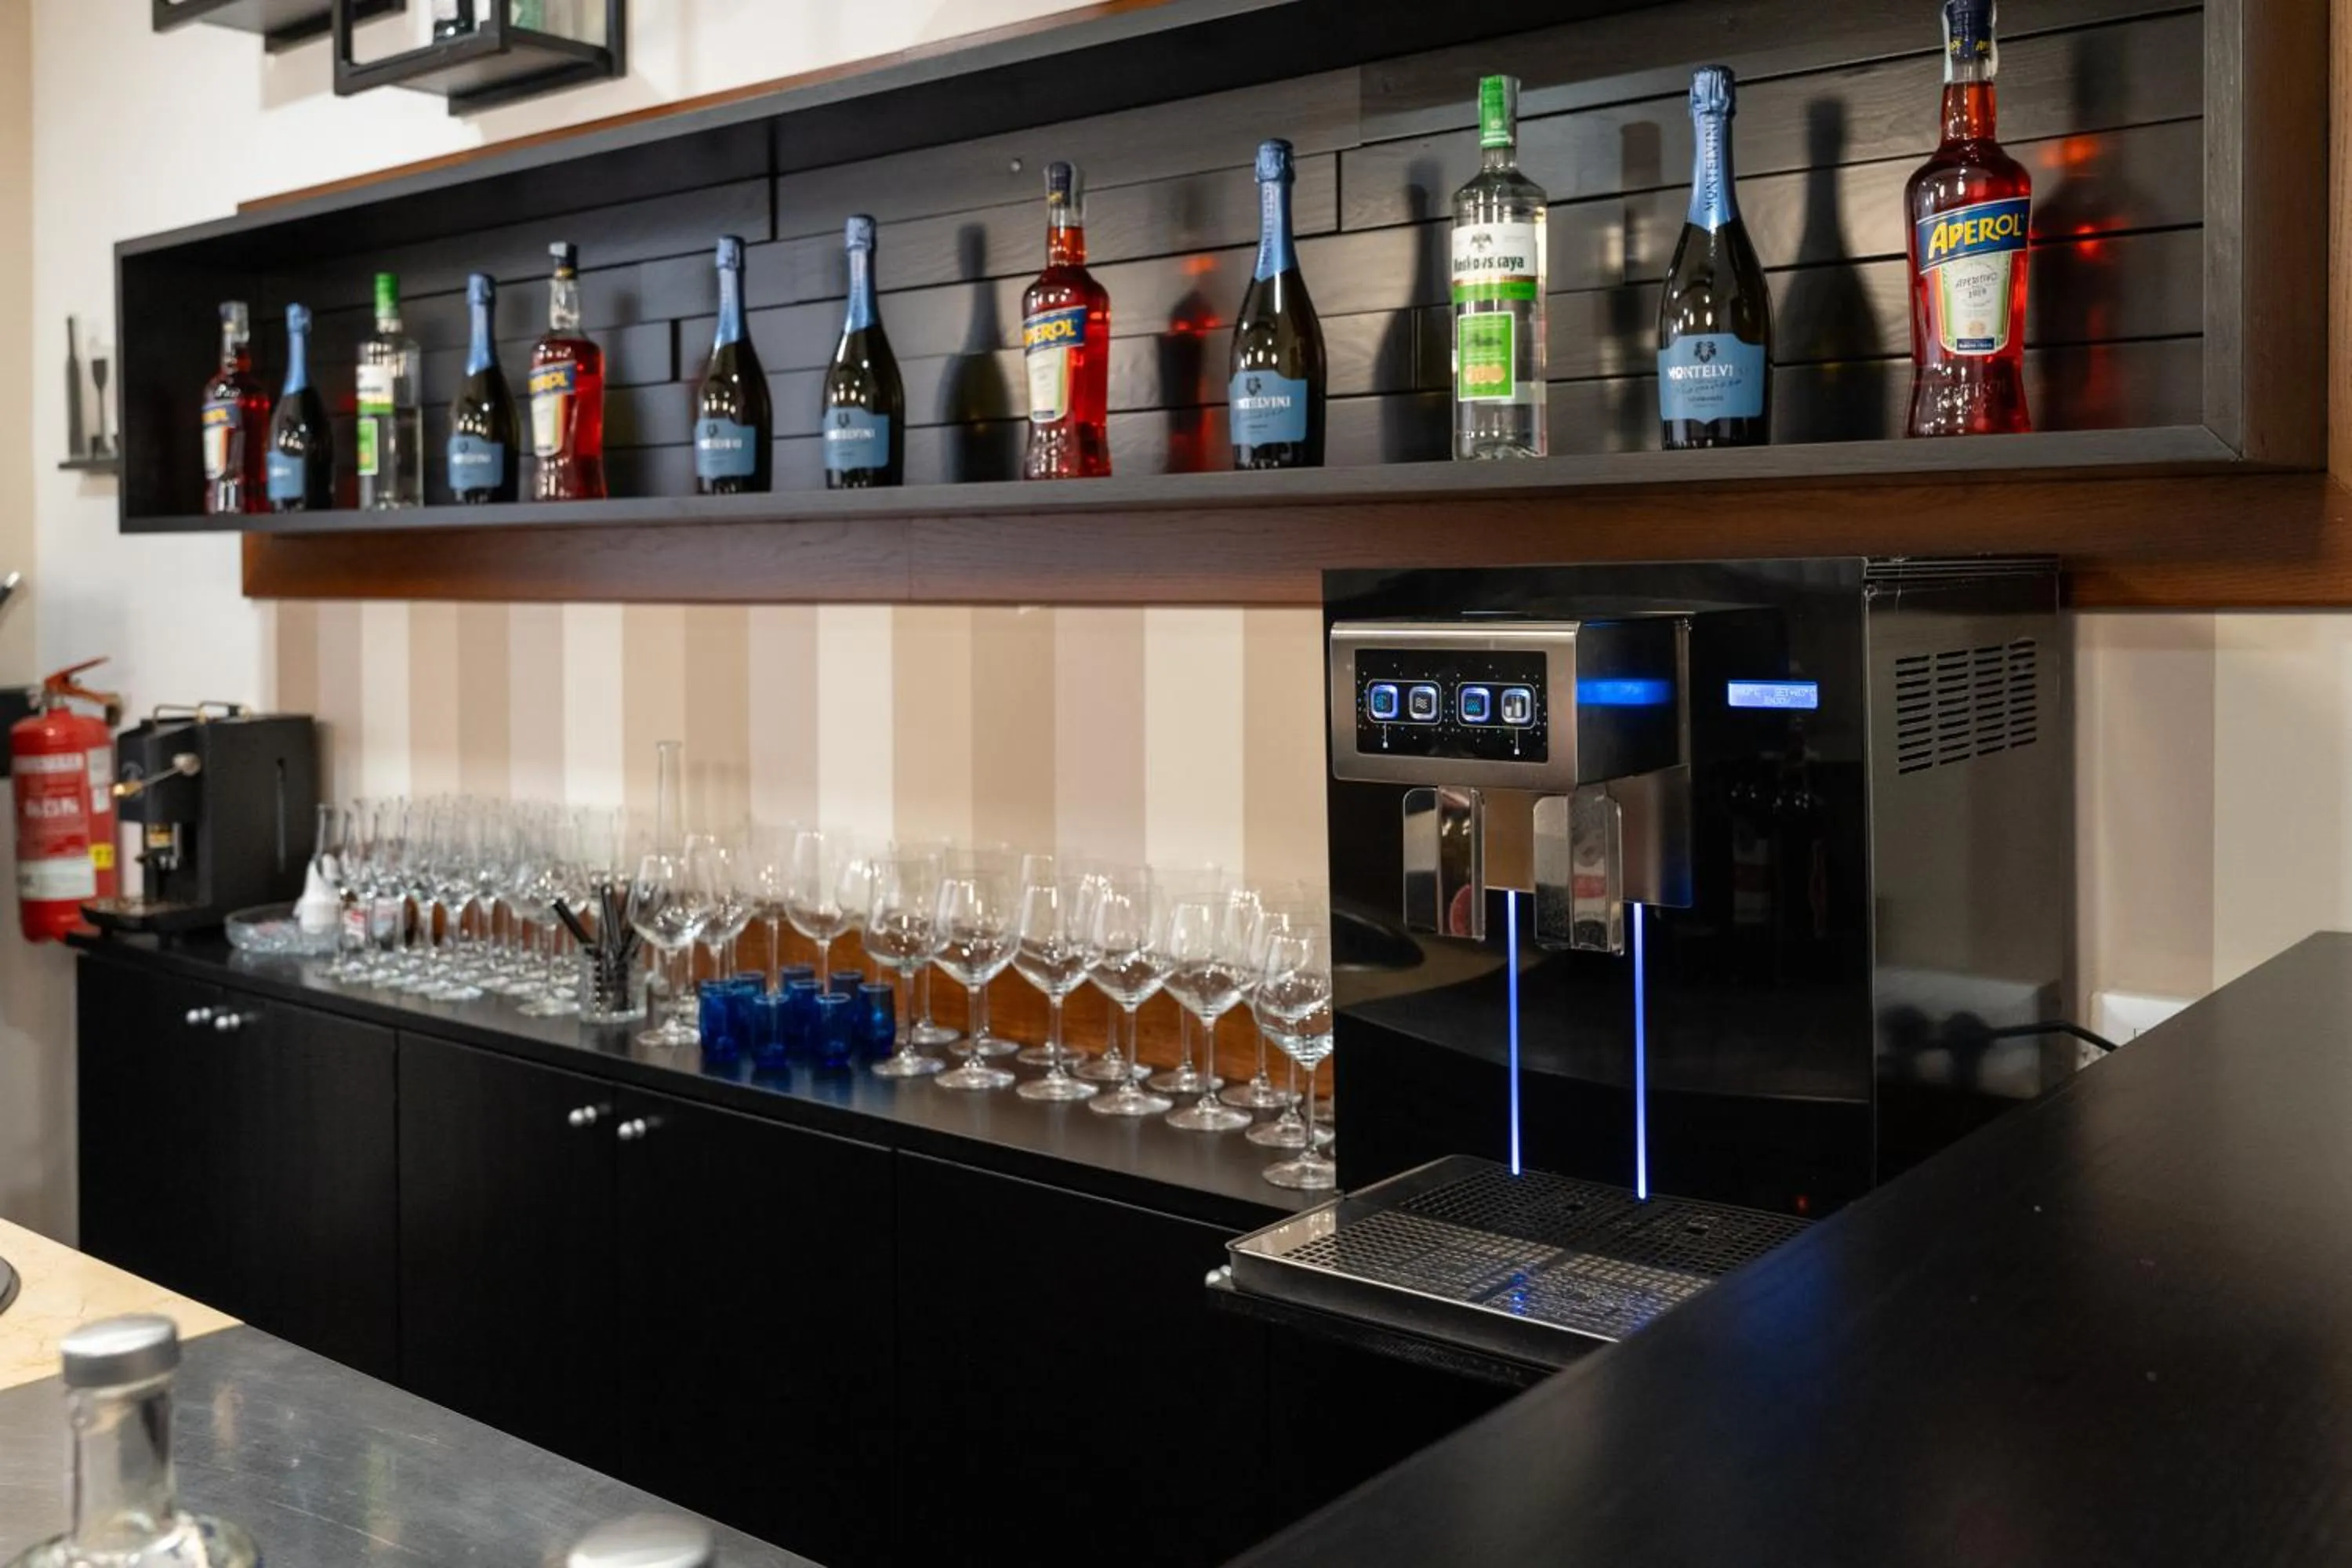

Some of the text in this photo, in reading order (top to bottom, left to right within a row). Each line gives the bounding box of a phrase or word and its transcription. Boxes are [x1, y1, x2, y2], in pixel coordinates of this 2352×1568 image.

[1928, 213, 2022, 260] APEROL
[1024, 318, 1076, 347] PEROL
[1667, 362, 1750, 382] MONTELVI
